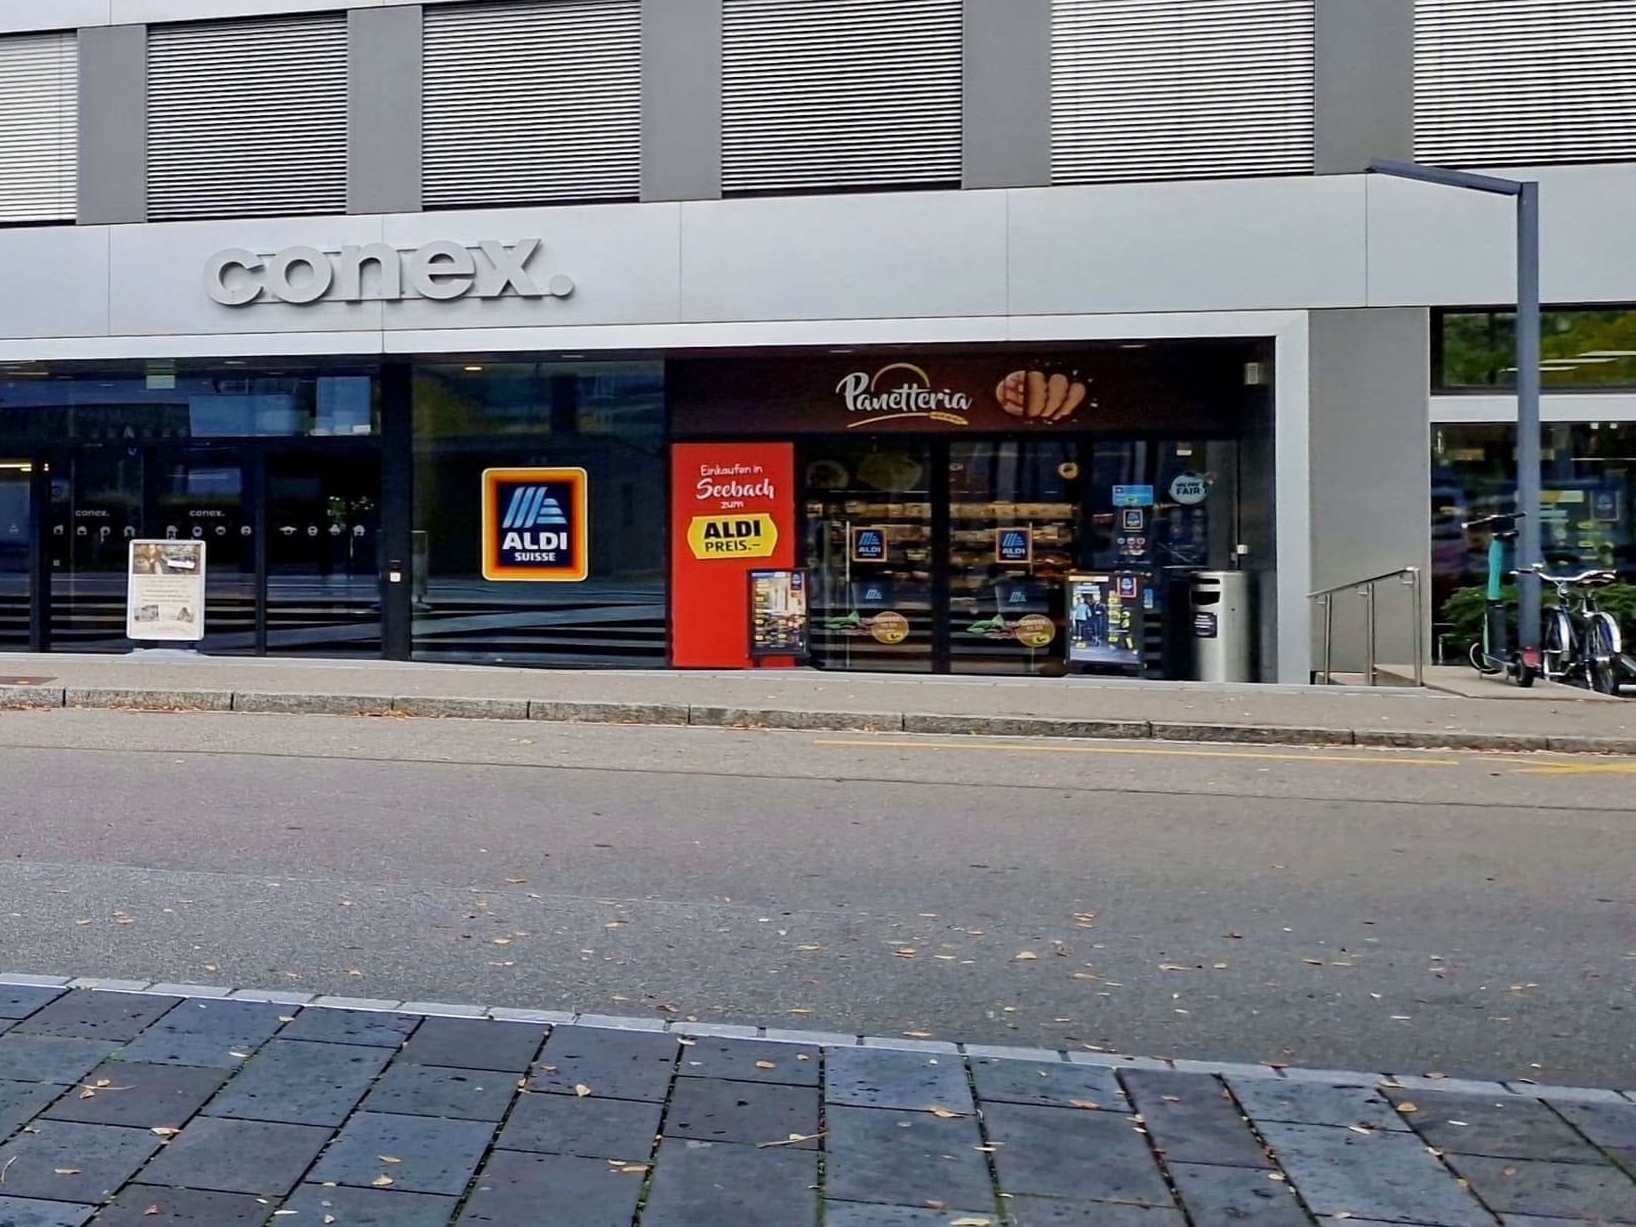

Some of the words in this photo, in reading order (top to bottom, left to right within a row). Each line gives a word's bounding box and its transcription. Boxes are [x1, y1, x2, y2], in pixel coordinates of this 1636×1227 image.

[204, 238, 574, 306] conex.
[835, 372, 972, 411] Panetteria
[700, 464, 752, 476] Einkaufen
[753, 465, 763, 474] in
[696, 478, 775, 500] Seebach
[1176, 487, 1201, 495] FAIR
[720, 500, 744, 509] zum
[704, 520, 762, 539] ALDI
[502, 532, 567, 550] ALDI
[514, 553, 556, 562] SUISSE
